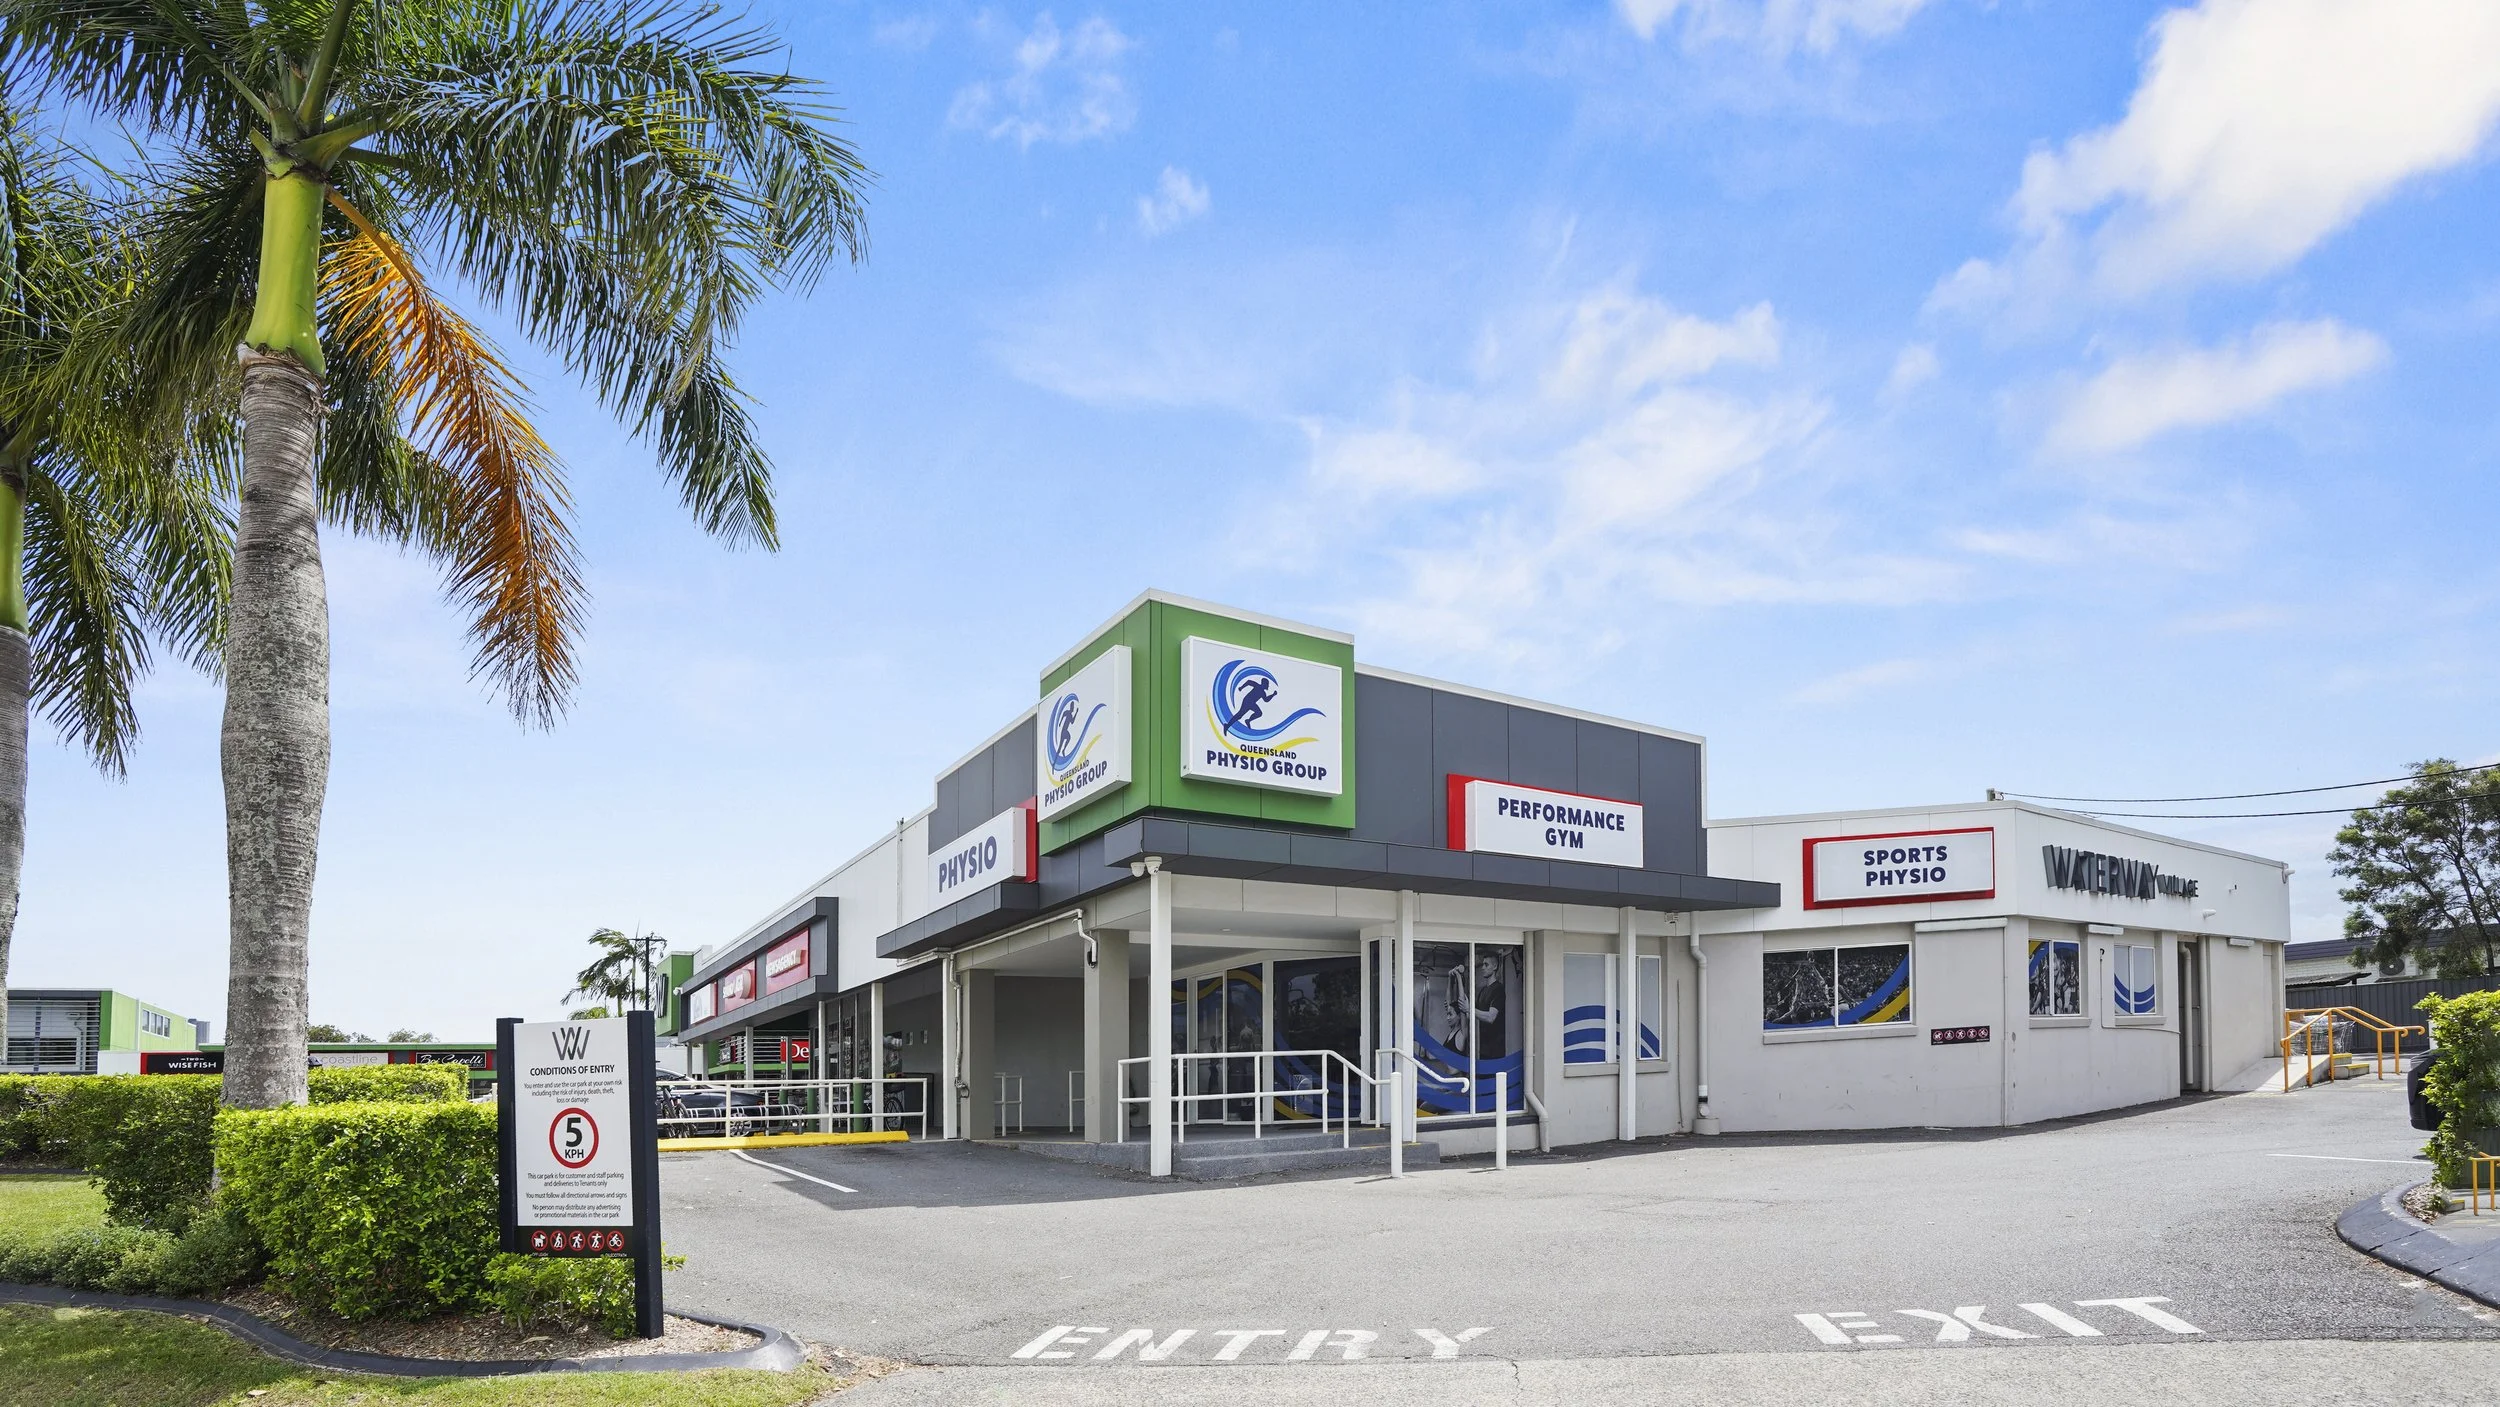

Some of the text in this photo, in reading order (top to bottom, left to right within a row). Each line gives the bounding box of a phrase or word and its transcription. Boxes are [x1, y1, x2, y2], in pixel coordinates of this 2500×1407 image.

[1240, 743, 1297, 760] QUEENSLAND
[1060, 759, 1090, 782] QUEENSLAND
[1206, 750, 1327, 781] PHYSIO GROUP
[1044, 760, 1108, 807] PHYSIO GROUP
[1498, 797, 1625, 832] PERFORMANCE
[1545, 827, 1584, 849] GYM
[938, 835, 997, 893] PHYSIO
[1863, 845, 1948, 866] SPORTS
[1865, 866, 1946, 887] PHYSIO
[2042, 844, 2199, 900] WATERWAY VILLAGE
[322, 1054, 378, 1065] coastline
[529, 1064, 615, 1077] CONDITIONS OF ENTRY
[565, 1117, 583, 1148] 5
[564, 1149, 584, 1159] KPH
[1793, 1295, 2208, 1345] EXIT
[1008, 1325, 1497, 1362] ENTRY
